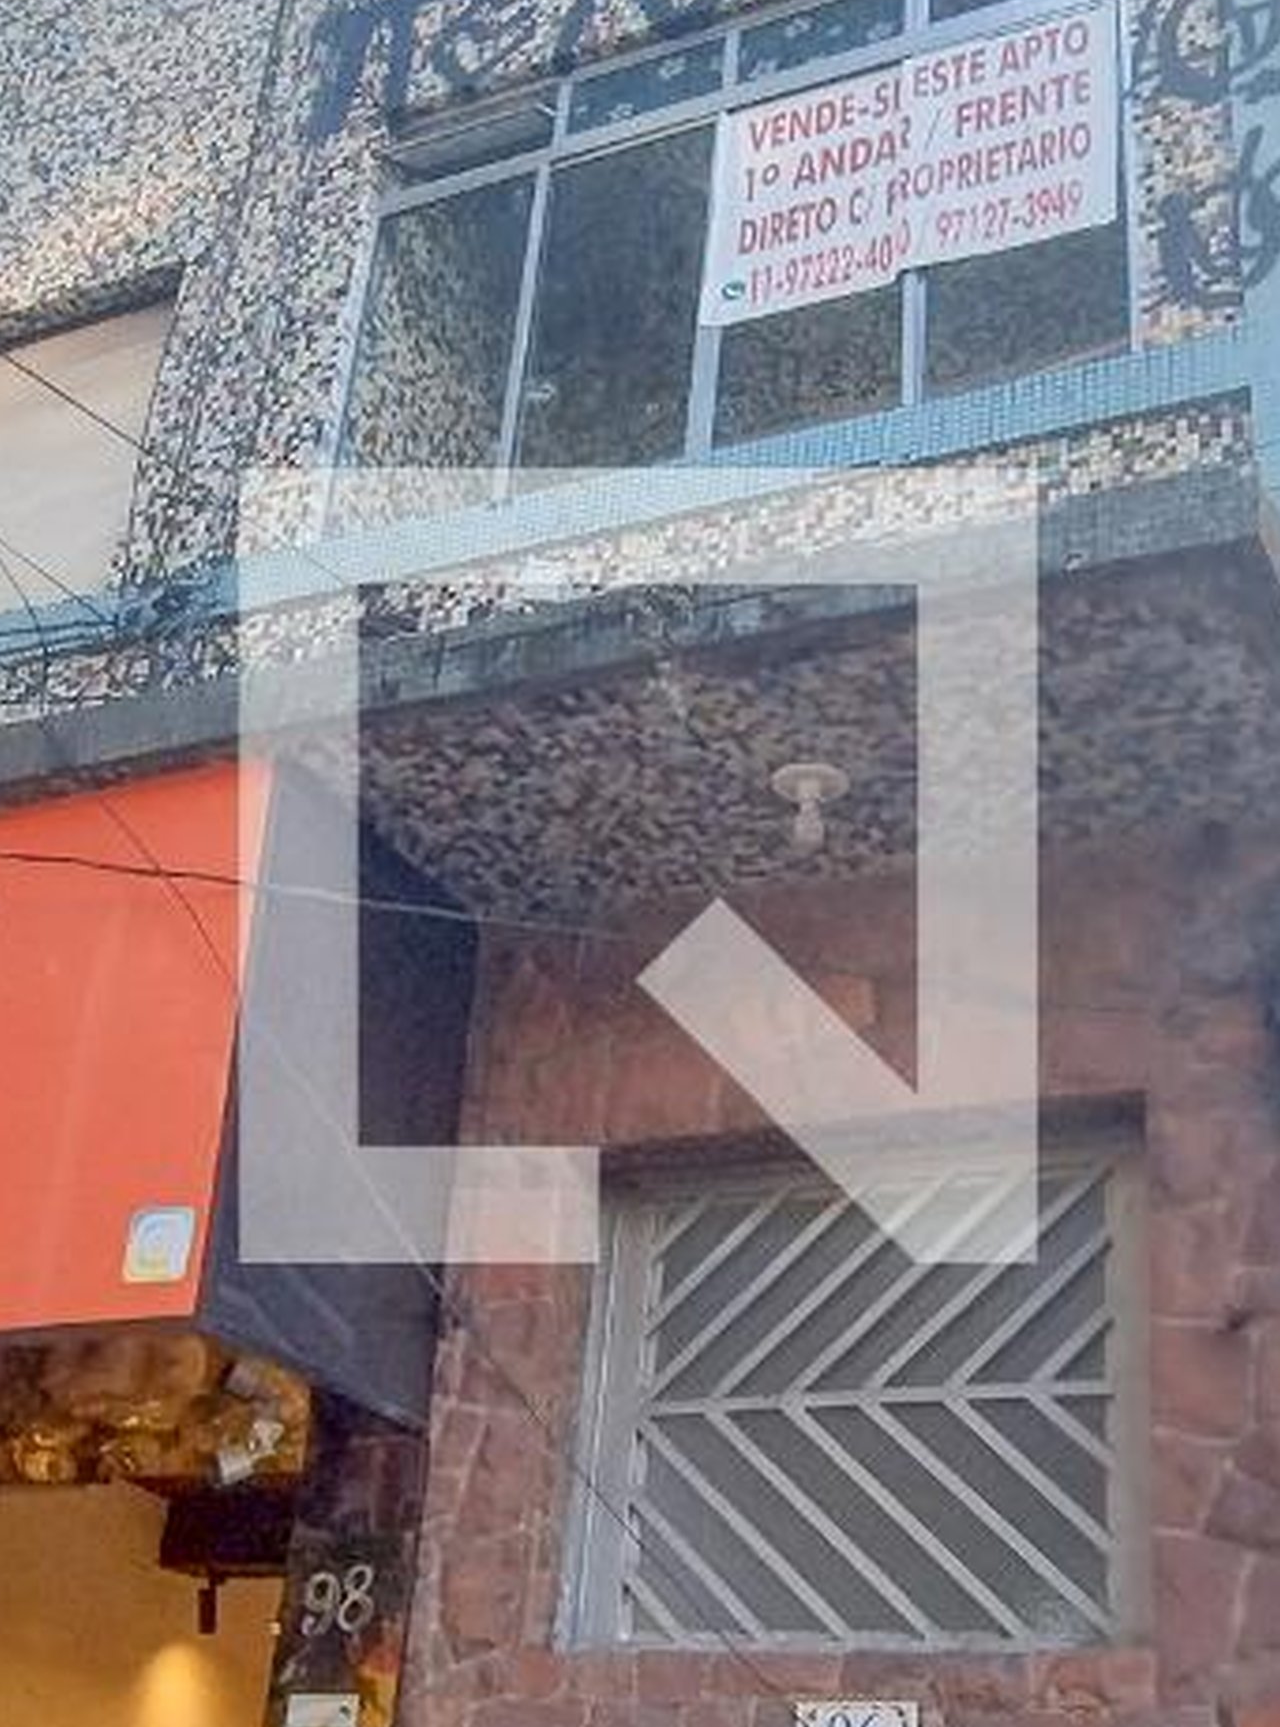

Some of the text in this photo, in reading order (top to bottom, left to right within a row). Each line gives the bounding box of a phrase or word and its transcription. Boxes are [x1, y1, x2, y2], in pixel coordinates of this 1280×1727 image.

[913, 49, 986, 97] ESTE
[998, 20, 1090, 76] APTO
[955, 70, 1092, 139] FRENTE
[738, 197, 836, 254] DIRETO
[301, 1564, 374, 1637] 98
